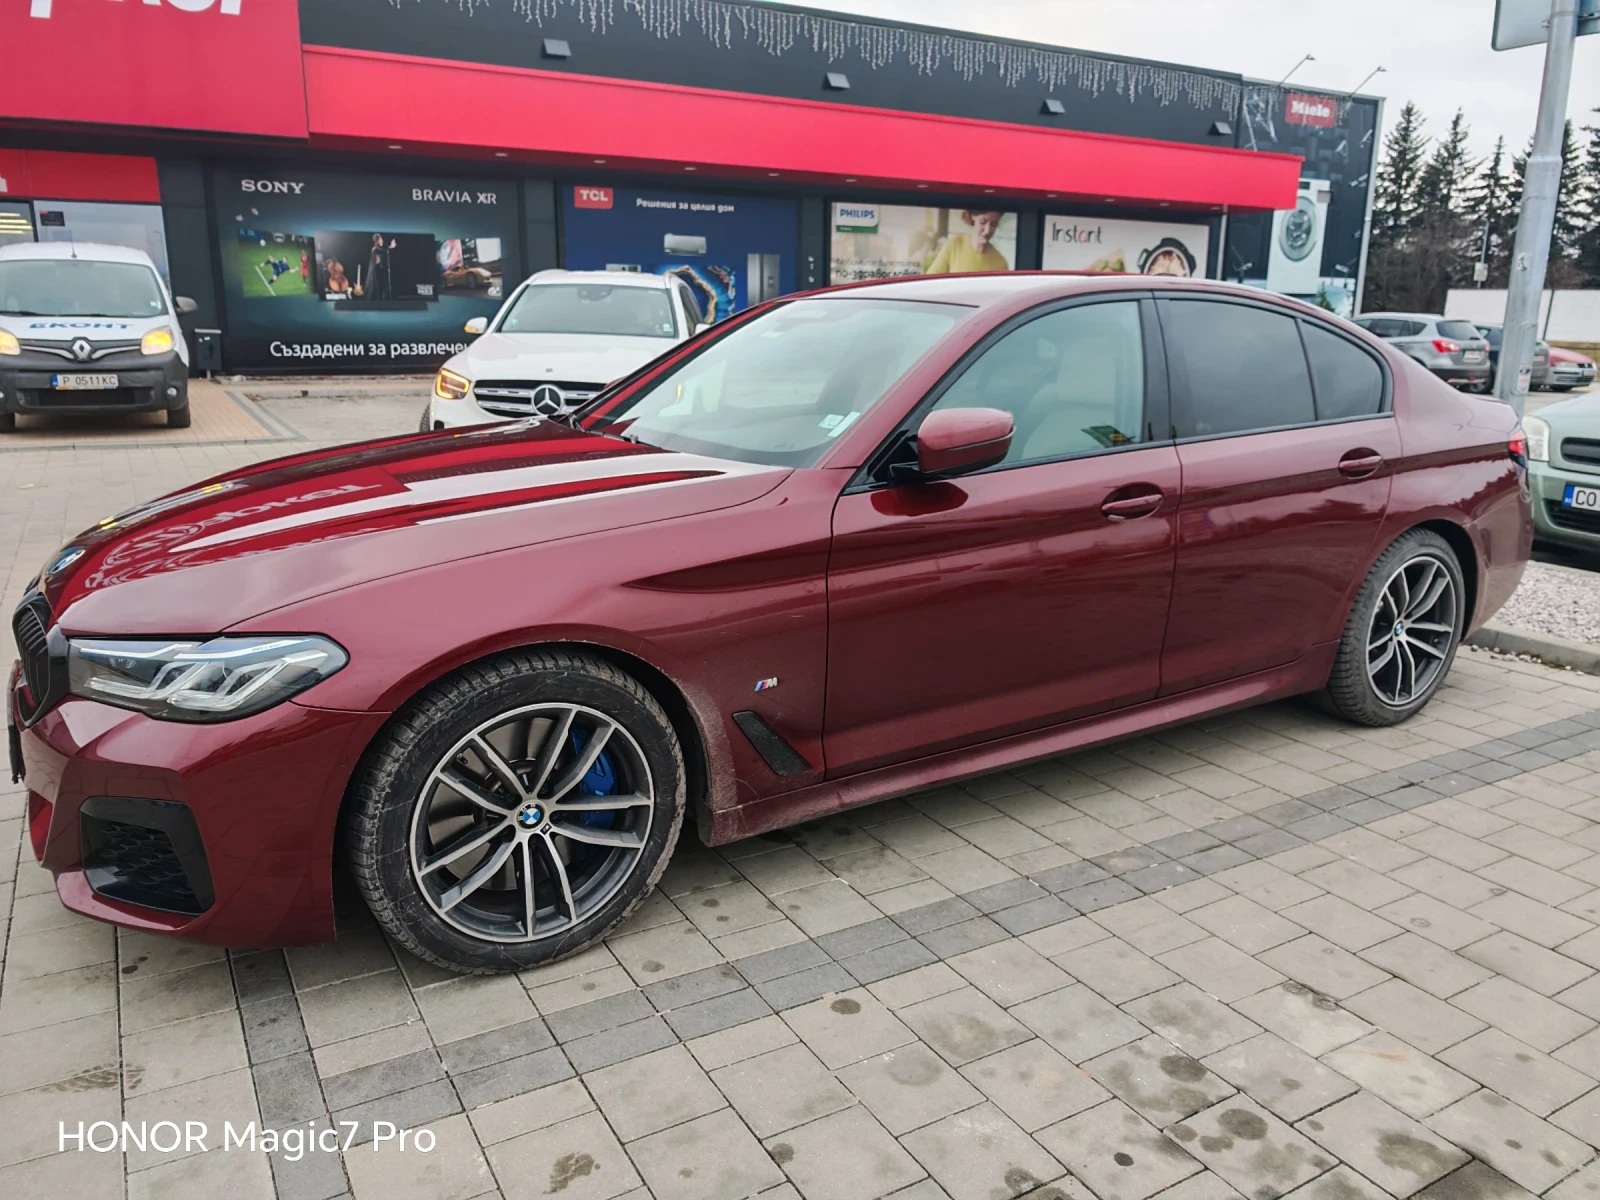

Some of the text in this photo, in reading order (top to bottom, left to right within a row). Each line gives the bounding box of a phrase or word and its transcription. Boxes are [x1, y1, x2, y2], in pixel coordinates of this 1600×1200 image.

[1291, 100, 1331, 118] Miele
[241, 179, 305, 194] SONY
[412, 188, 497, 205] BRAVIA XR
[580, 189, 609, 202] TCL
[636, 198, 735, 213] Решения за целия дом
[840, 208, 875, 219] PHILIPS
[270, 341, 364, 358] Създадени
[368, 344, 386, 356] за
